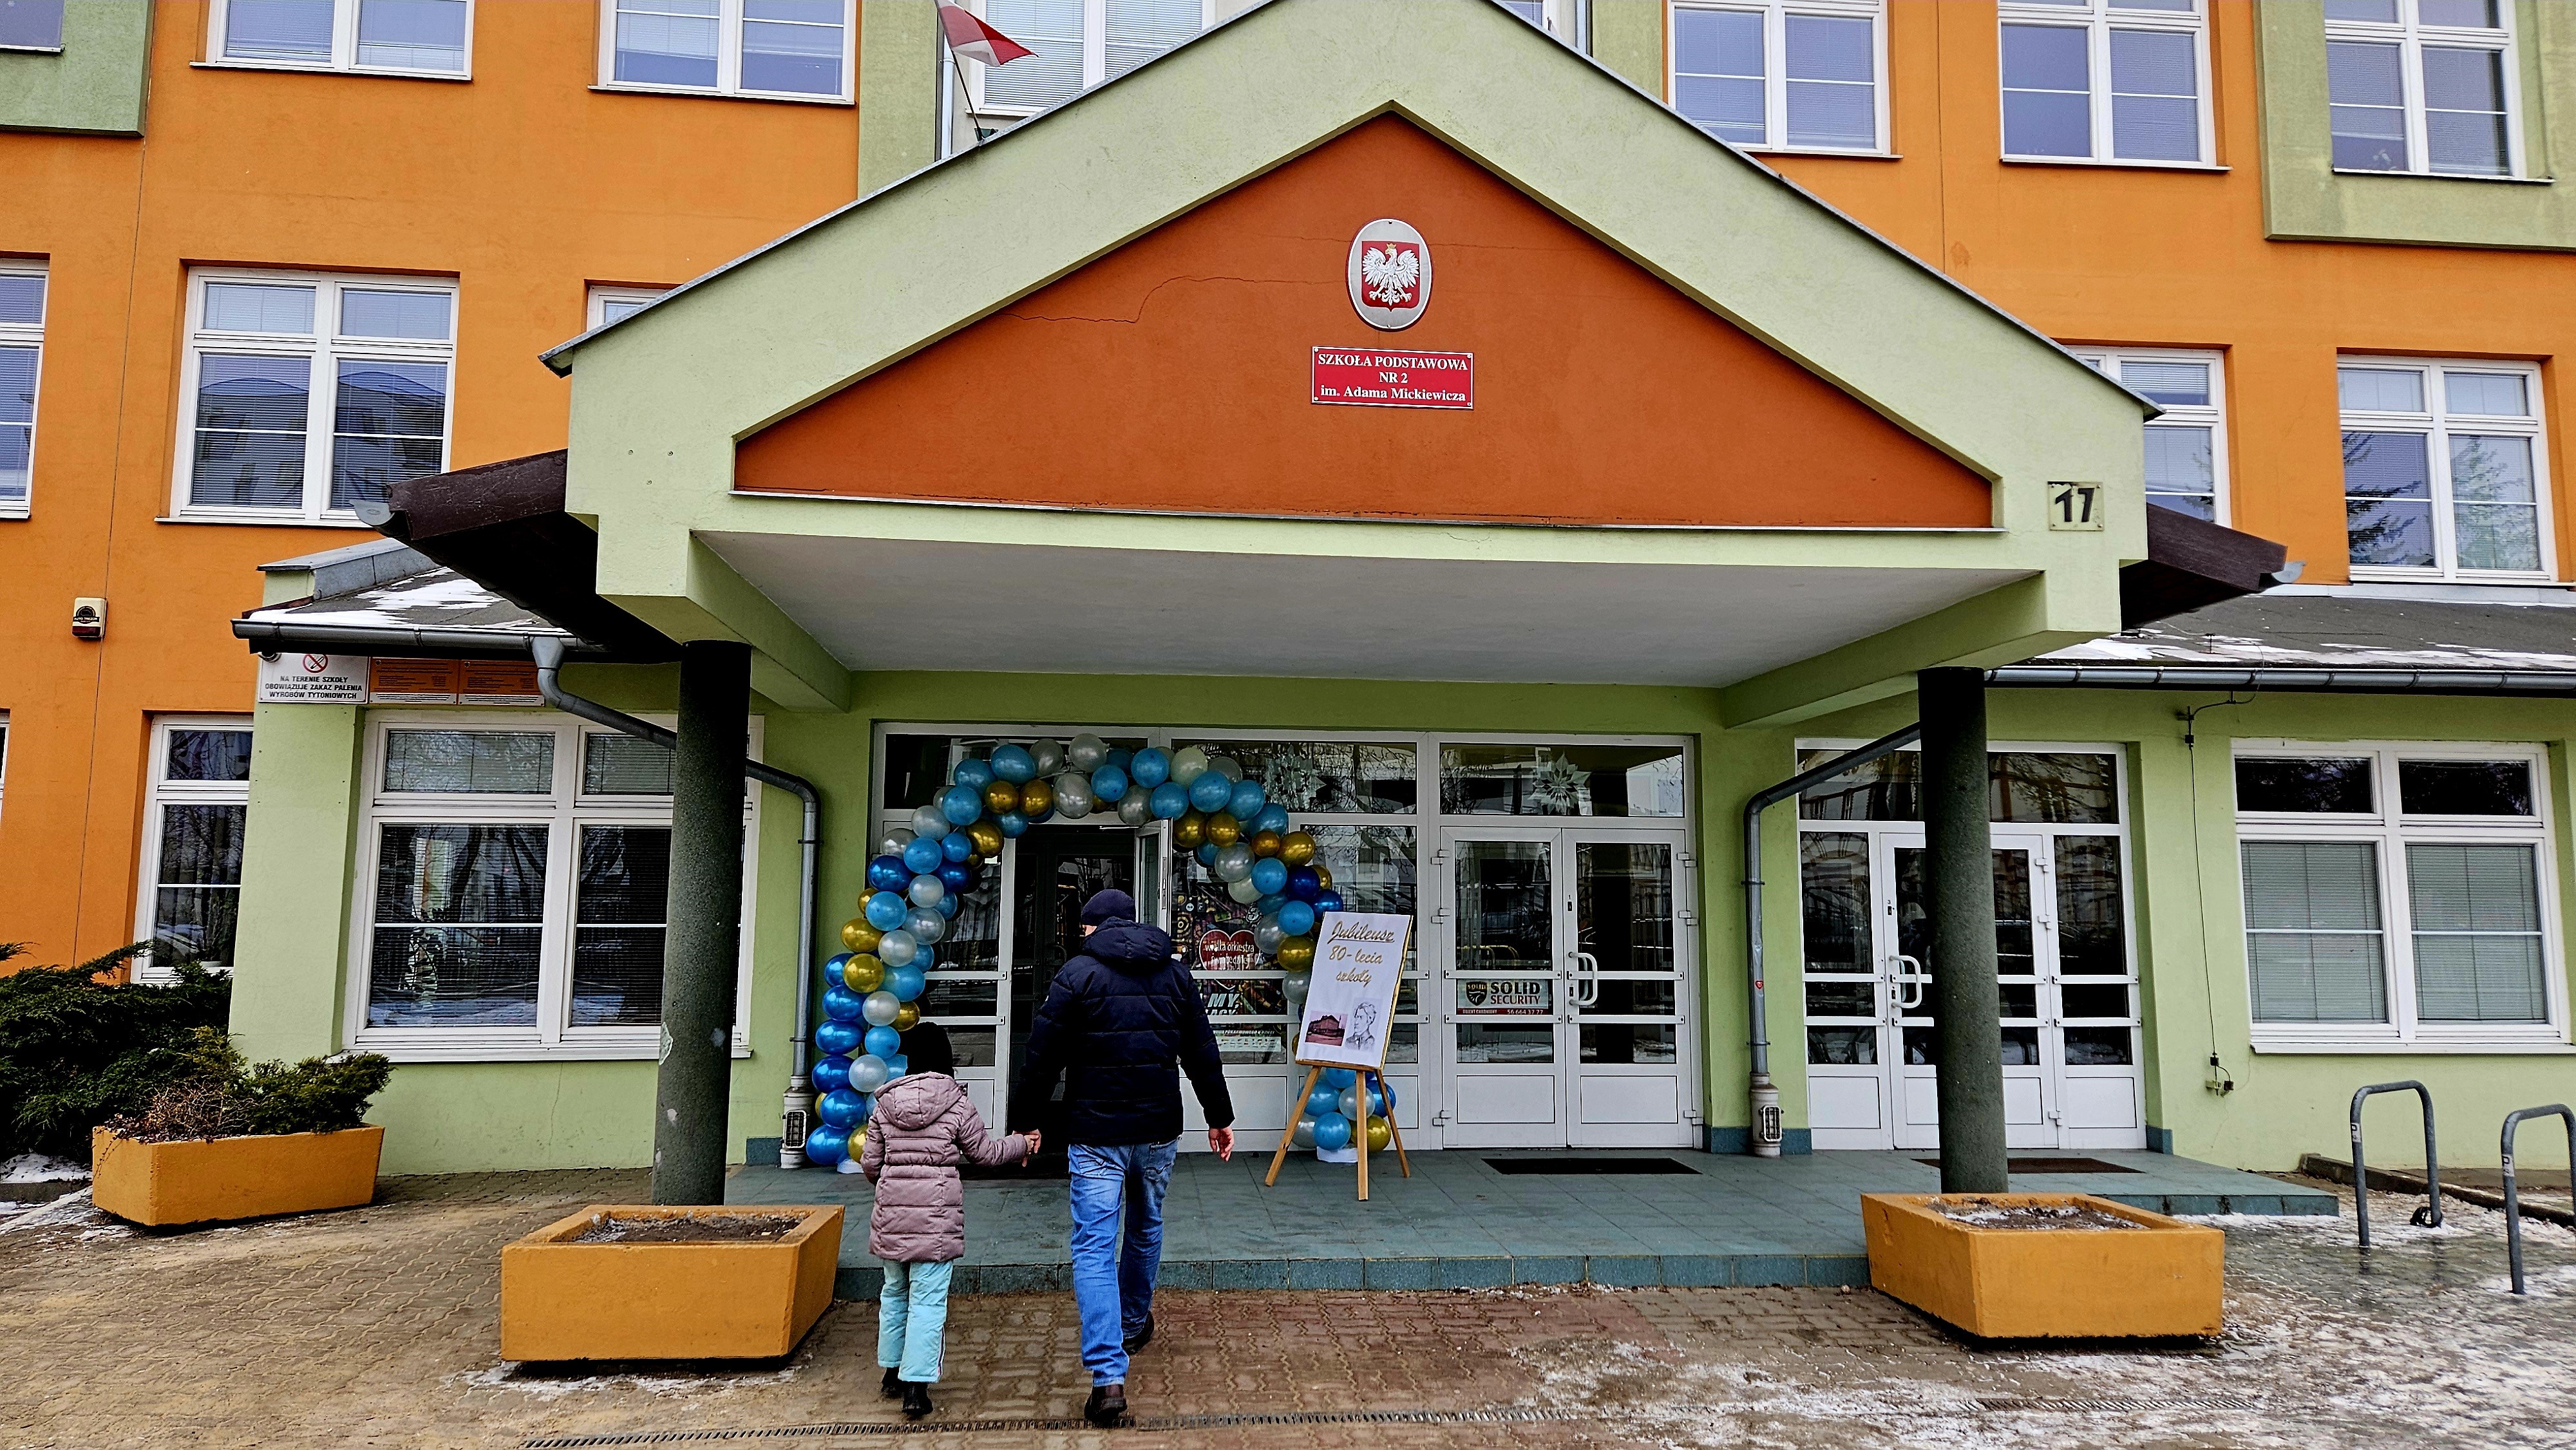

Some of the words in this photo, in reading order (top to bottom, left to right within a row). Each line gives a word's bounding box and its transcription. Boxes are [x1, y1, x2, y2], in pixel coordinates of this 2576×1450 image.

[1318, 353, 1372, 367] SZKOŁA
[1375, 356, 1468, 371] PODSTAWOWA
[1379, 372, 1399, 383] NR
[1401, 372, 1408, 384] 2
[1321, 385, 1341, 397] im.
[1343, 386, 1387, 399] Adama
[1391, 387, 1466, 401] Mickiewicza
[2055, 487, 2096, 522] 17
[1327, 921, 1396, 945] Jubileusz
[1227, 941, 1255, 953] orkiestra
[1336, 968, 1372, 988] szkoły
[1490, 981, 1540, 995] SOLID
[1490, 995, 1540, 1004] SECURITY
